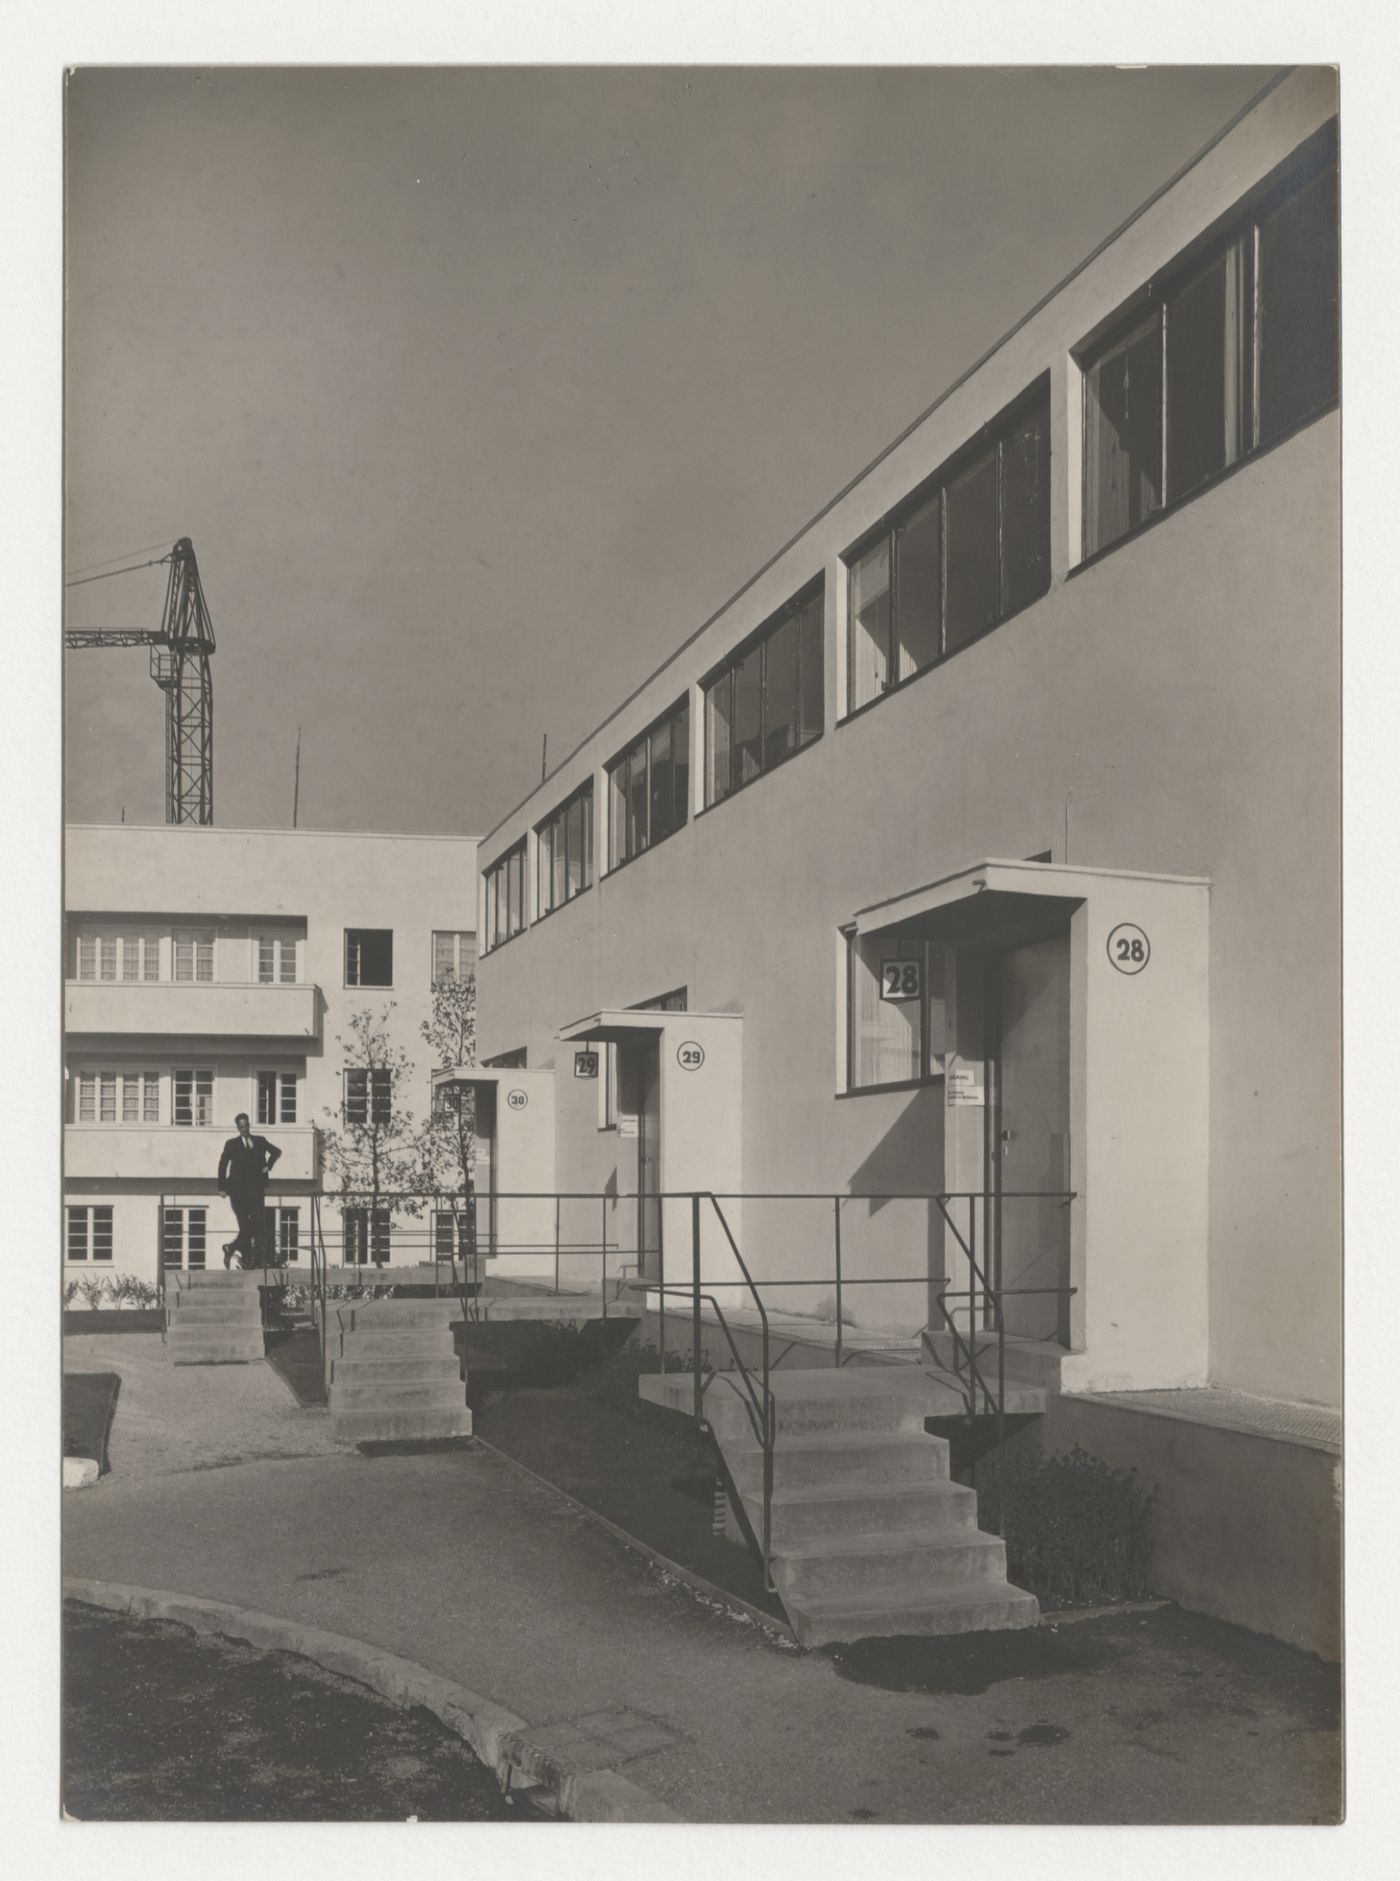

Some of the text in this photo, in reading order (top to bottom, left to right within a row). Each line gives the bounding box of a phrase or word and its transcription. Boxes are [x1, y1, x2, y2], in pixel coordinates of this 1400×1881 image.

[1117, 938, 1145, 962] 28
[886, 965, 918, 994] 28
[578, 1057, 595, 1074] 29
[682, 1050, 701, 1064] 29
[511, 1095, 525, 1105] 30
